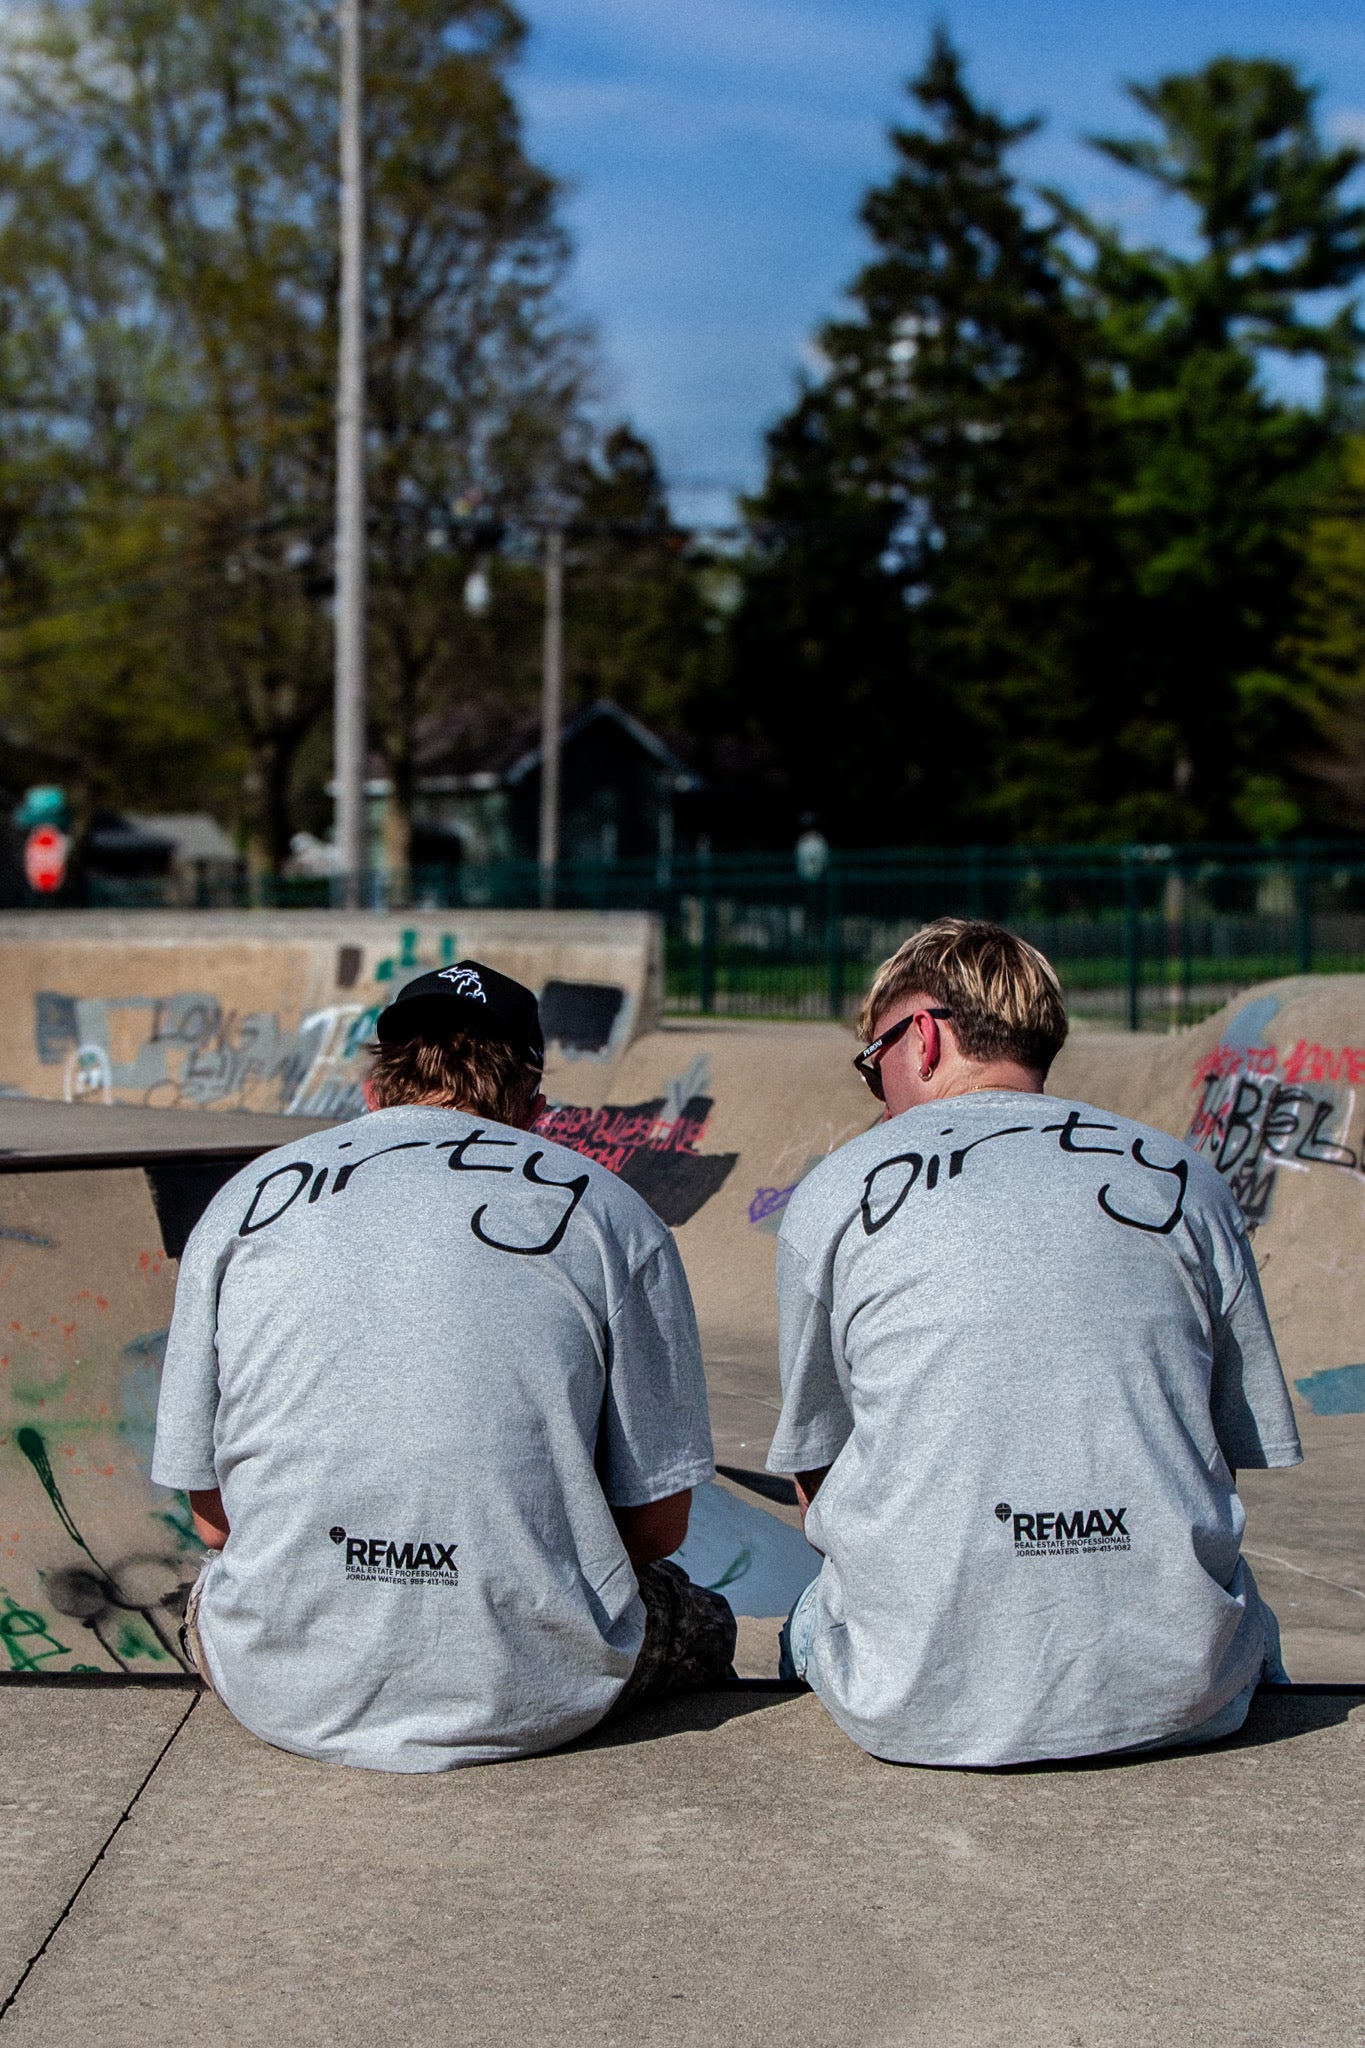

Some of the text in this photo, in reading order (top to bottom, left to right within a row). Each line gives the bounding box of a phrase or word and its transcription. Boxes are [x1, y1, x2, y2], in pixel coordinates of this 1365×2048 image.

[860, 1111, 1188, 1236] Dirty
[239, 1130, 590, 1256] Dirty
[1013, 1508, 1130, 1541] REMAX
[346, 1538, 459, 1571] REMAX
[1014, 1536, 1131, 1550] REAL ESTATE PROFESSIONALS
[1016, 1544, 1132, 1558] JORDAN WATERS 989-413-1082
[346, 1565, 459, 1579] REAL ESTATE PROFESSIONALS
[346, 1573, 459, 1587] JORDAN WATERS 989-413-1082
